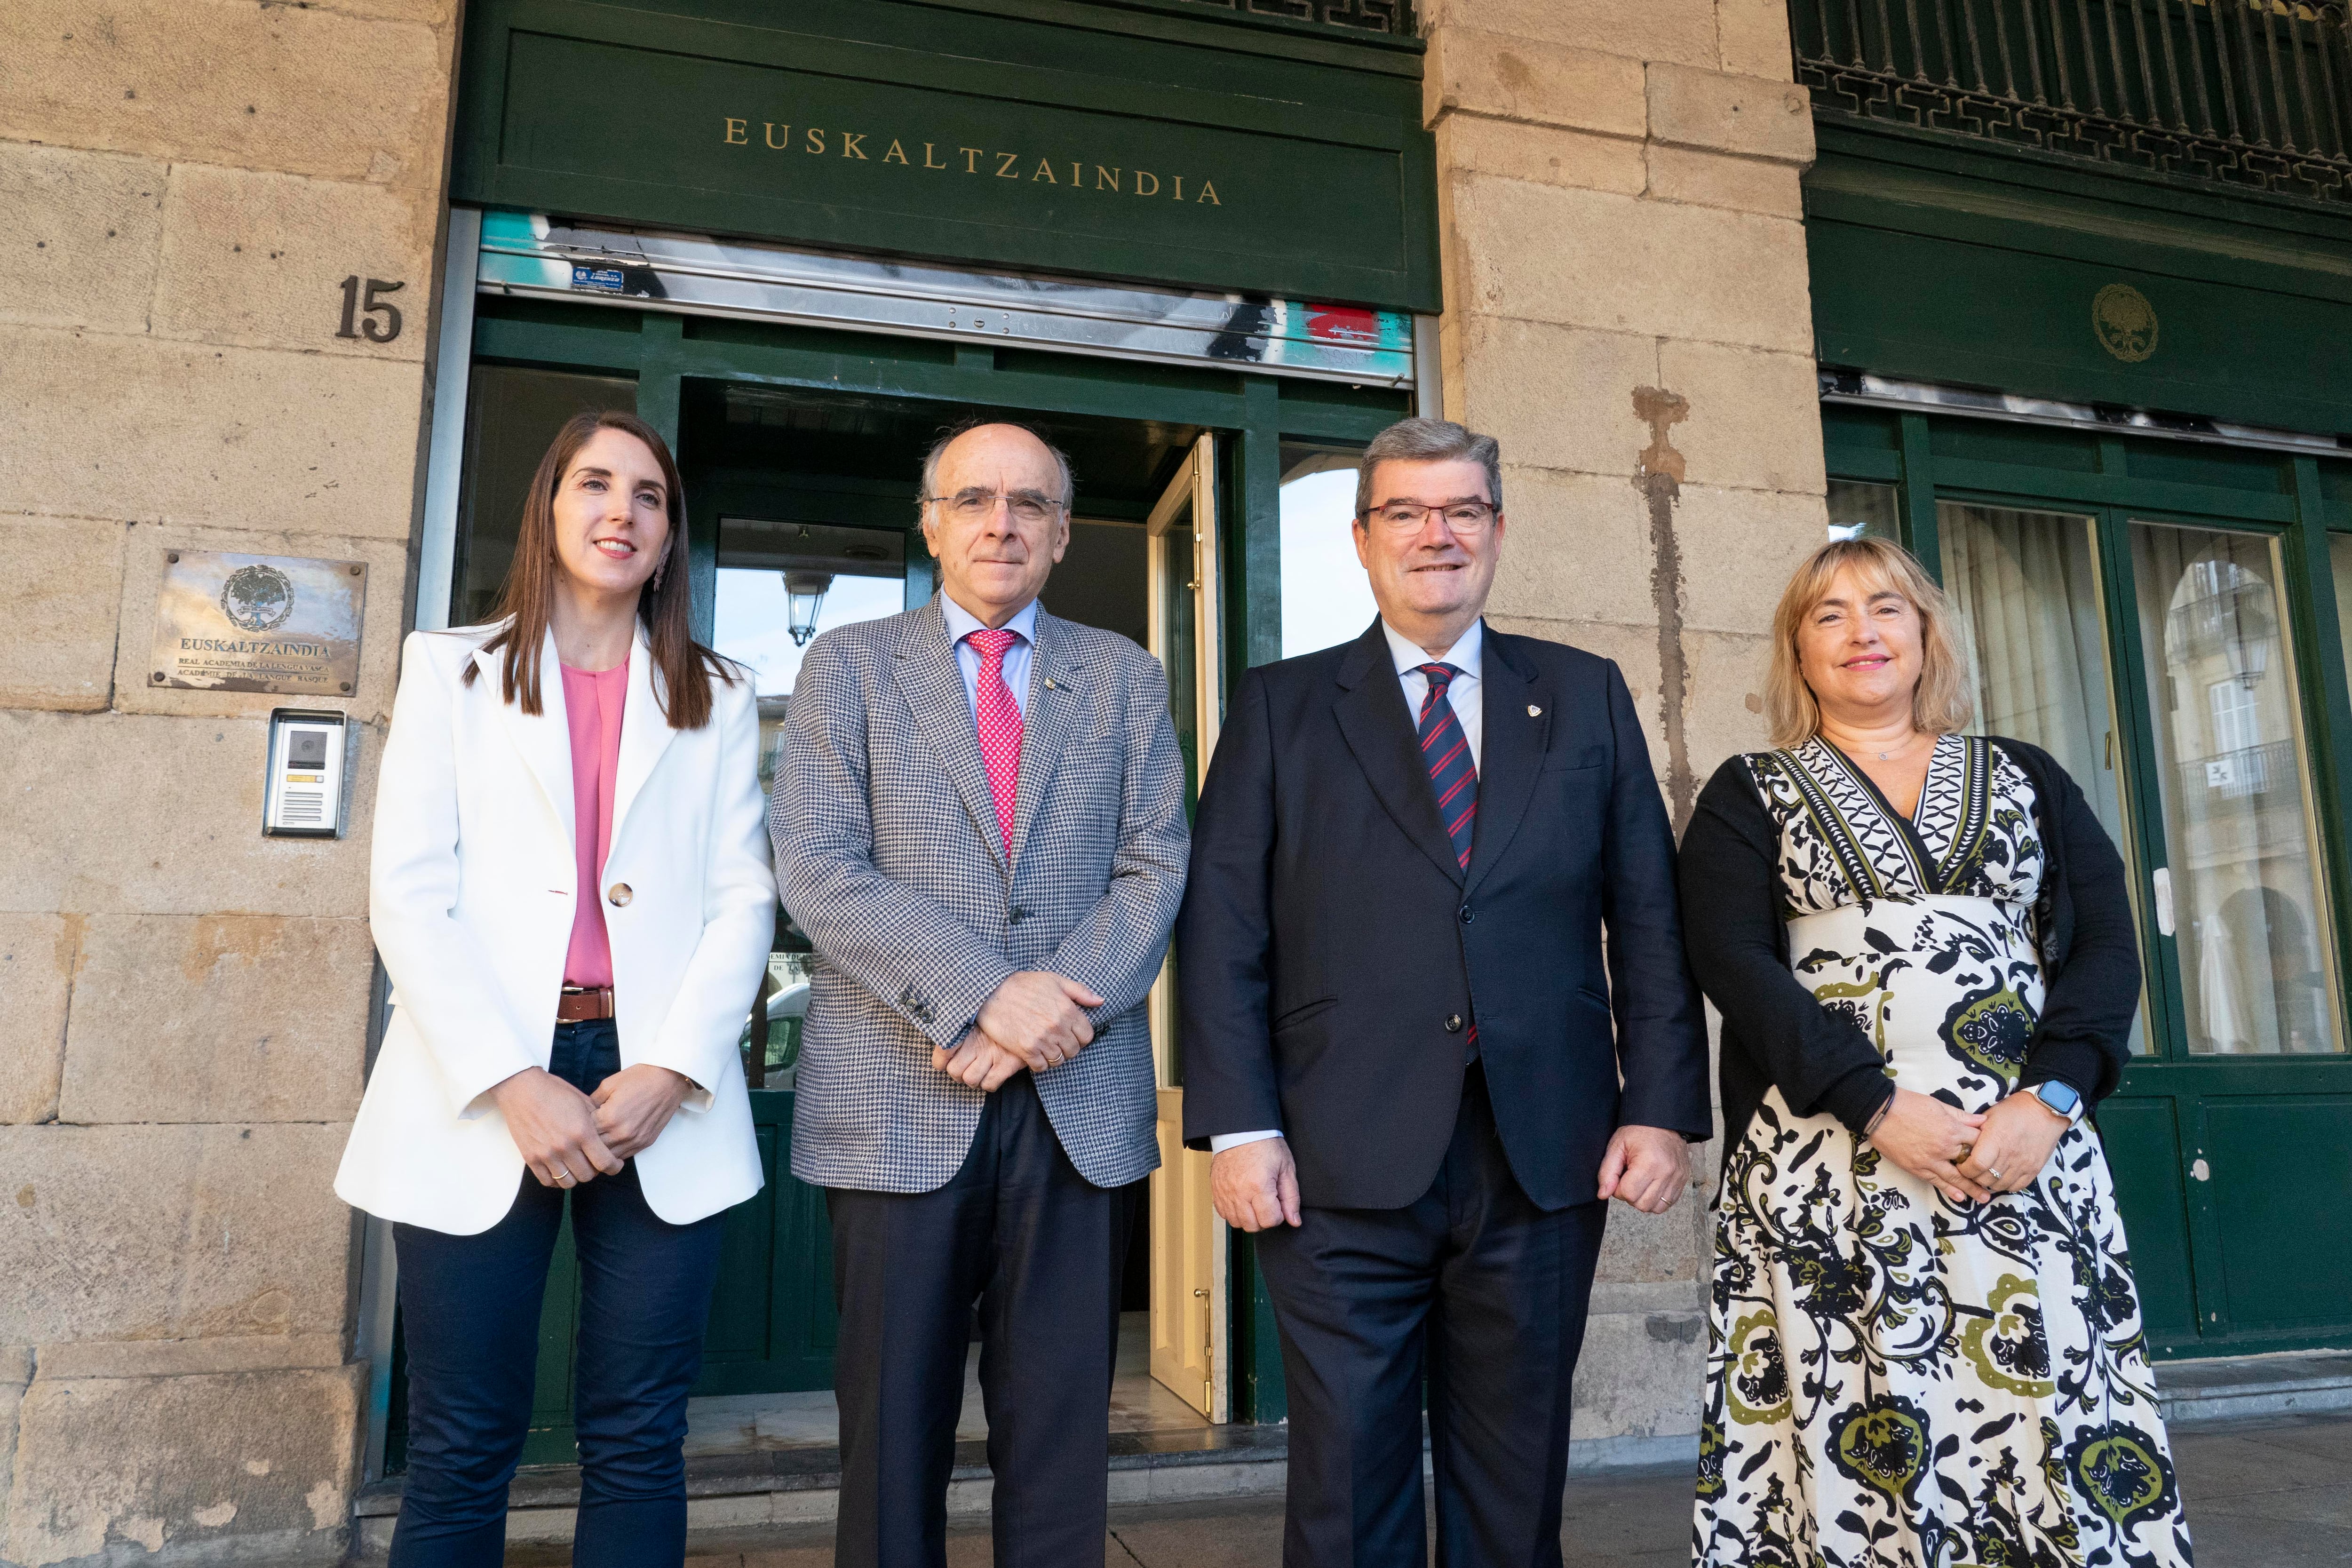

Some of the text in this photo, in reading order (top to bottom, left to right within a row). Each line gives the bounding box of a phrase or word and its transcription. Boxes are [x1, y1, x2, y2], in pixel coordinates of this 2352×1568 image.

[723, 117, 1222, 206] EUSKALTZAINDIA
[334, 274, 405, 343] 15
[181, 638, 330, 658] EUSKALTZAINDIA
